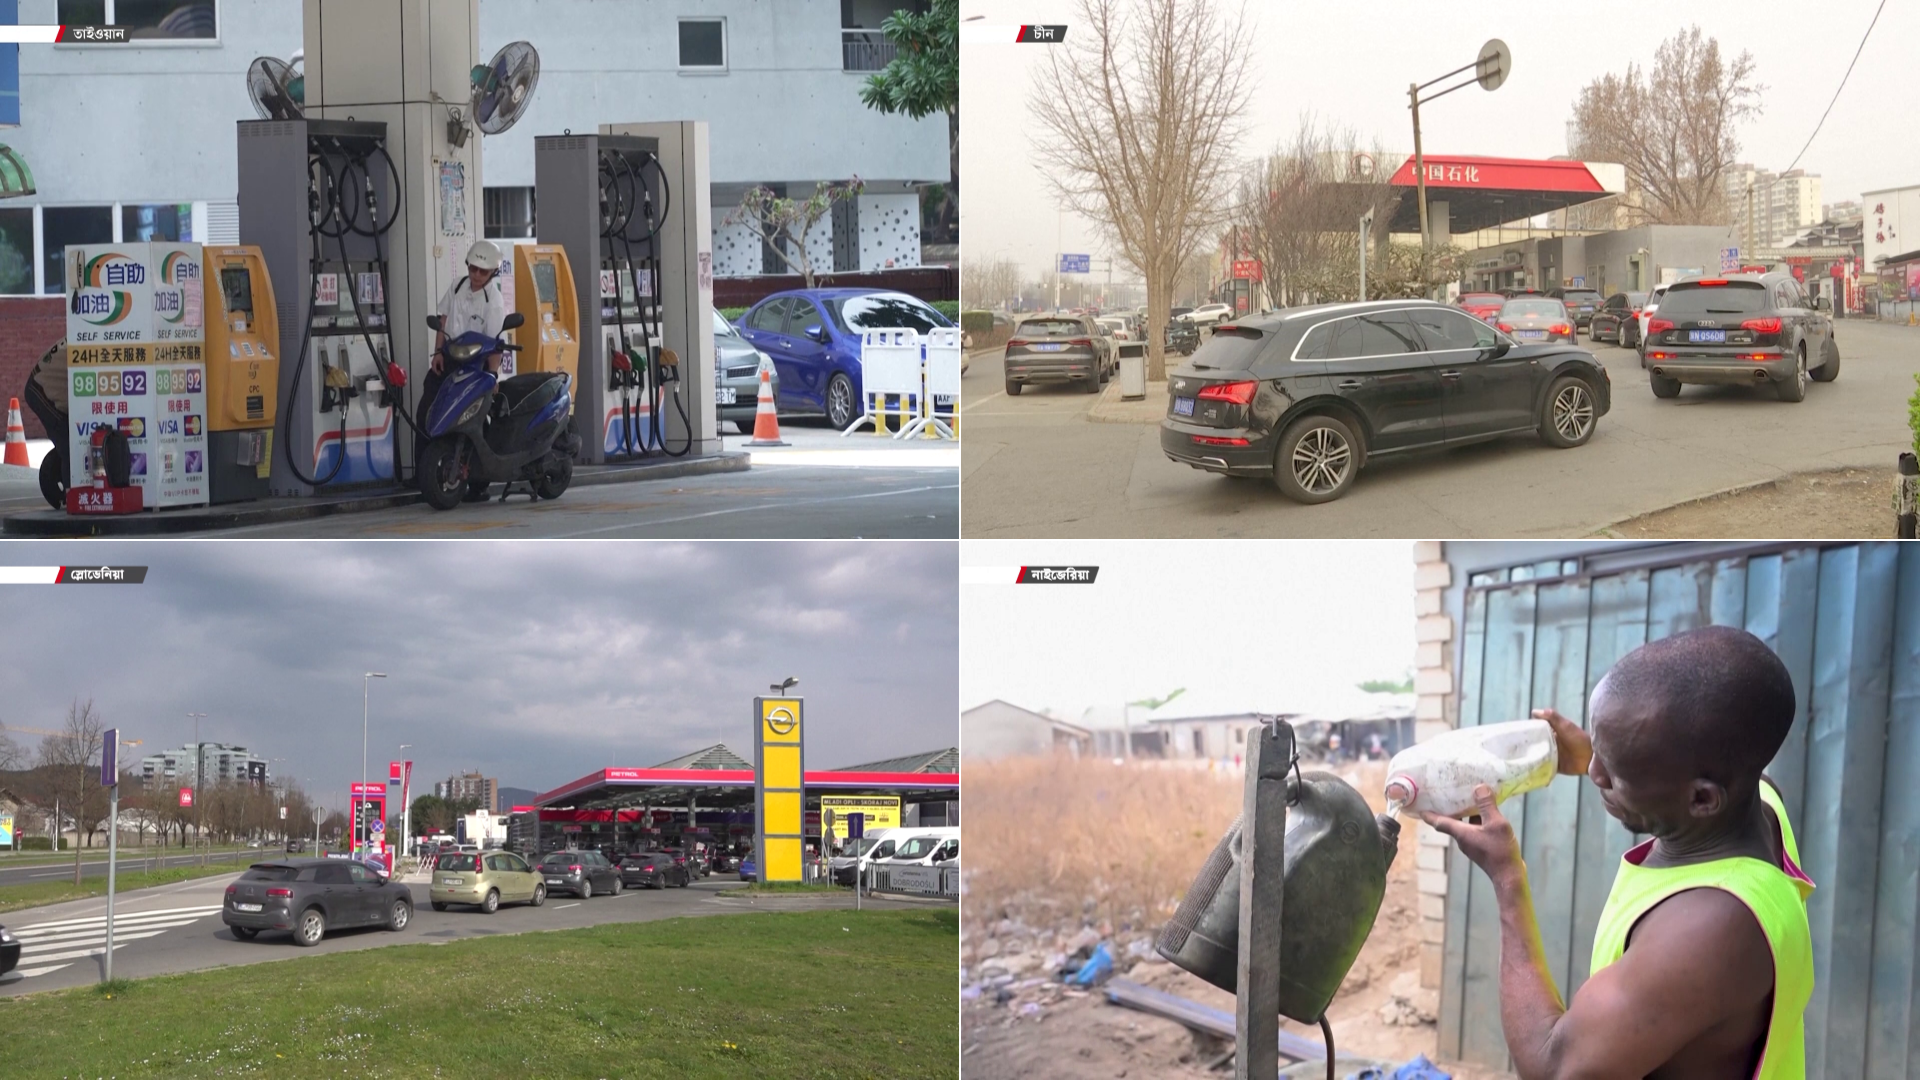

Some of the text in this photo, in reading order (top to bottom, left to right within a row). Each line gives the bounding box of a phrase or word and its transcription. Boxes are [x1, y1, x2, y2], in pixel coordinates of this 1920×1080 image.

[1412, 164, 1479, 183] 中国石化
[107, 263, 145, 285] 自助
[176, 263, 199, 282] 自助
[73, 294, 109, 314] 加油
[154, 291, 178, 311] 加油
[77, 331, 141, 341] SELF SERVICE
[158, 329, 197, 339] SELF SERVICE
[72, 348, 146, 363] 24H全天服務
[503, 357, 512, 371] 92
[74, 374, 145, 392] 98 95 92
[157, 373, 200, 390] 98 95 92
[249, 385, 260, 393] CPC
[92, 401, 128, 415] 限使用
[168, 399, 191, 413] 限使用
[158, 420, 178, 435] VISA
[78, 492, 113, 505] 滅火器
[893, 878, 935, 888] DOBRODOŠLI
